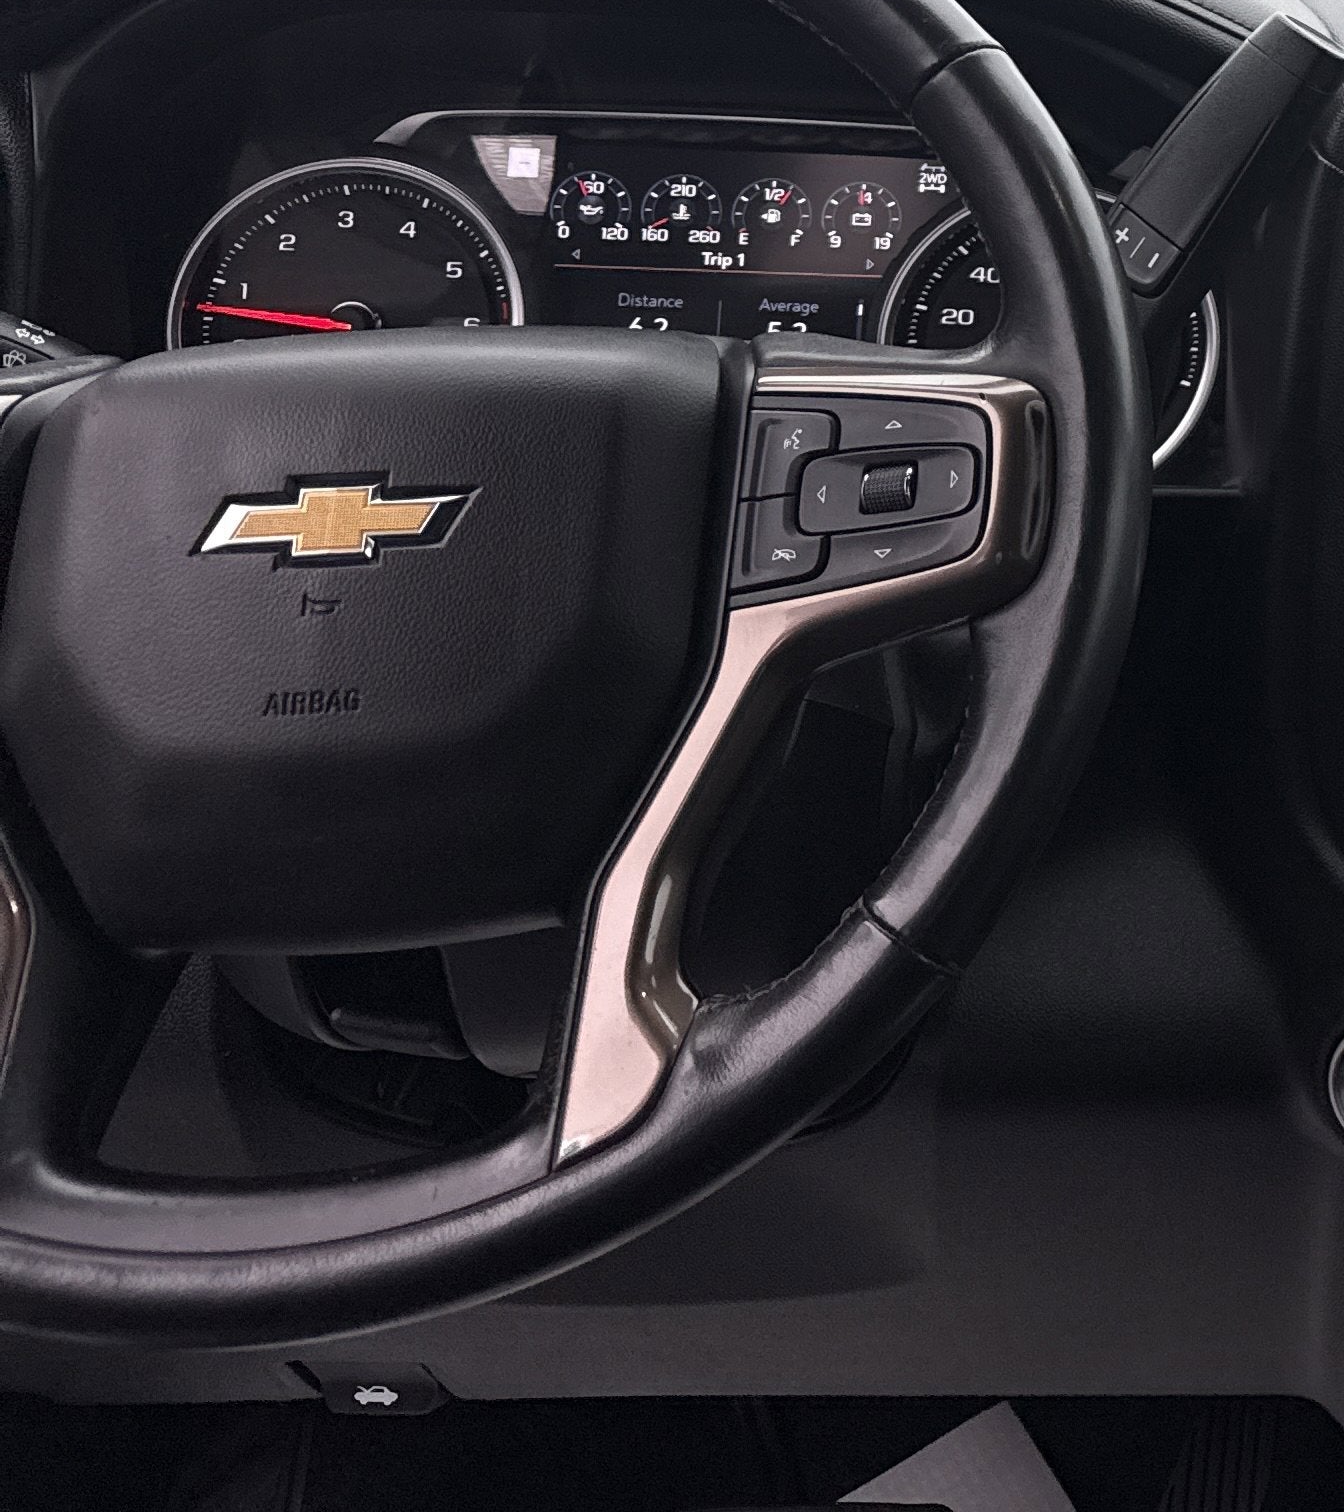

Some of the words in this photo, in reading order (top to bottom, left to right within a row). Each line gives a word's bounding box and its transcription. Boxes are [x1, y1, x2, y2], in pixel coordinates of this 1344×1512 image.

[919, 173, 947, 183] 2WD
[670, 184, 697, 198] 210
[337, 211, 355, 229] 3
[399, 221, 417, 238] 4
[557, 225, 570, 239] 0
[601, 227, 629, 241] 120
[641, 228, 669, 242] 160
[688, 230, 721, 244] 260
[278, 234, 297, 252] 2
[738, 233, 749, 245] E
[790, 235, 801, 247] F
[829, 235, 842, 248] 9
[874, 236, 891, 250] 19
[701, 252, 733, 270] Trip
[737, 253, 745, 267] 1
[445, 261, 463, 279] 5
[239, 282, 248, 300] 1
[617, 292, 684, 309] Distance
[758, 298, 820, 317] Average
[940, 308, 975, 325] 20
[262, 689, 362, 717] AIRBAG
